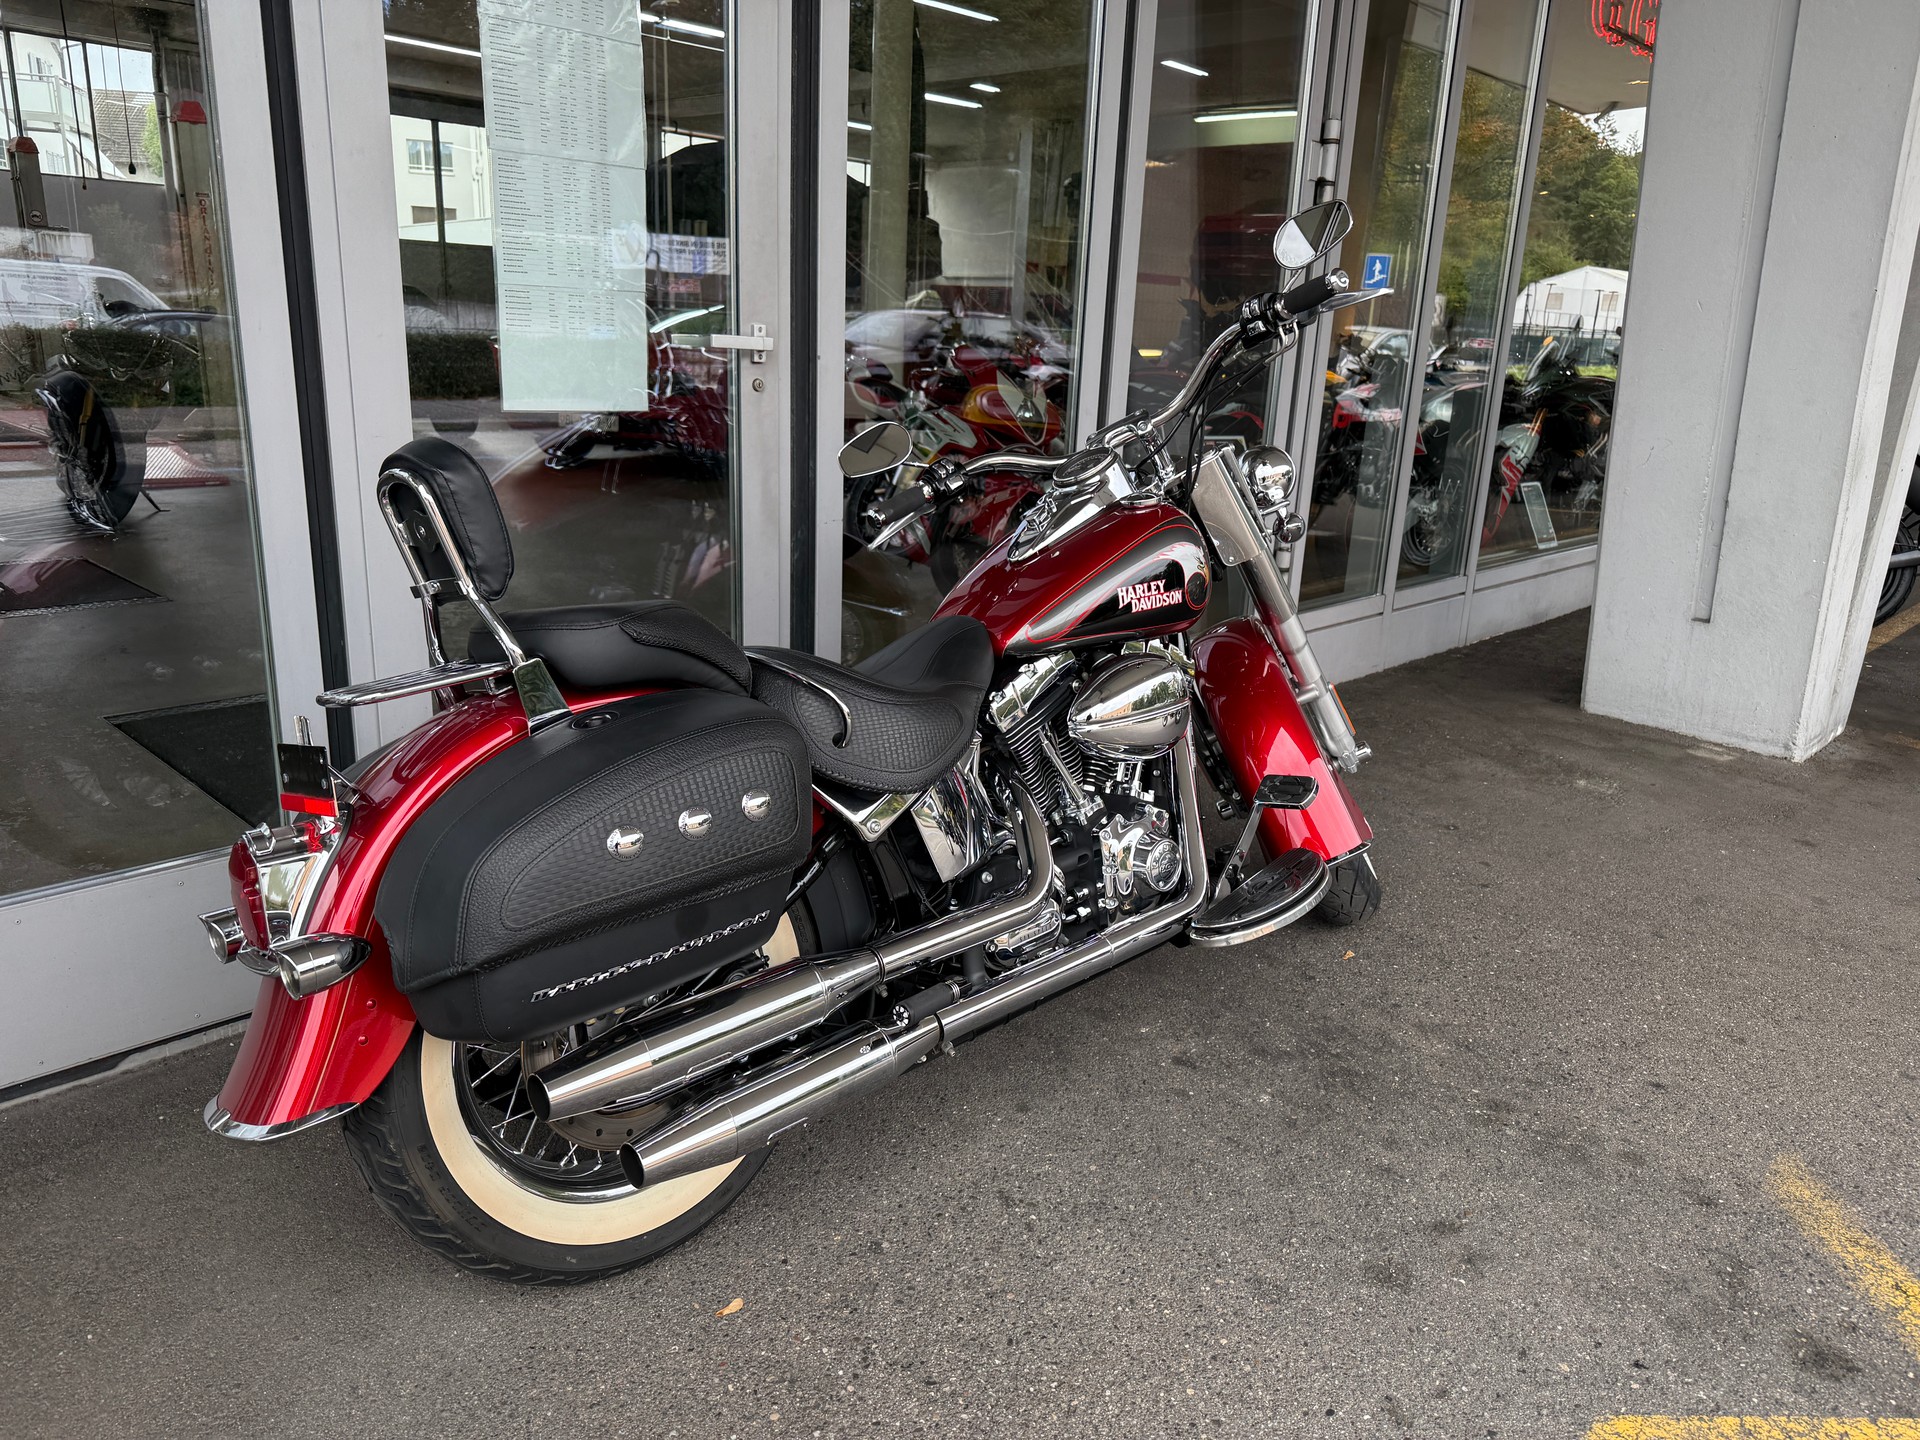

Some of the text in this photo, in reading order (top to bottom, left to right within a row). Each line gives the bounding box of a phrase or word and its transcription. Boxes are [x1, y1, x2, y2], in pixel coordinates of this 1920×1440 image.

[1117, 579, 1166, 609] HARLEY
[1131, 590, 1183, 613] DAVIDSON
[530, 909, 771, 1003] HARLEY-DAVIDSON
